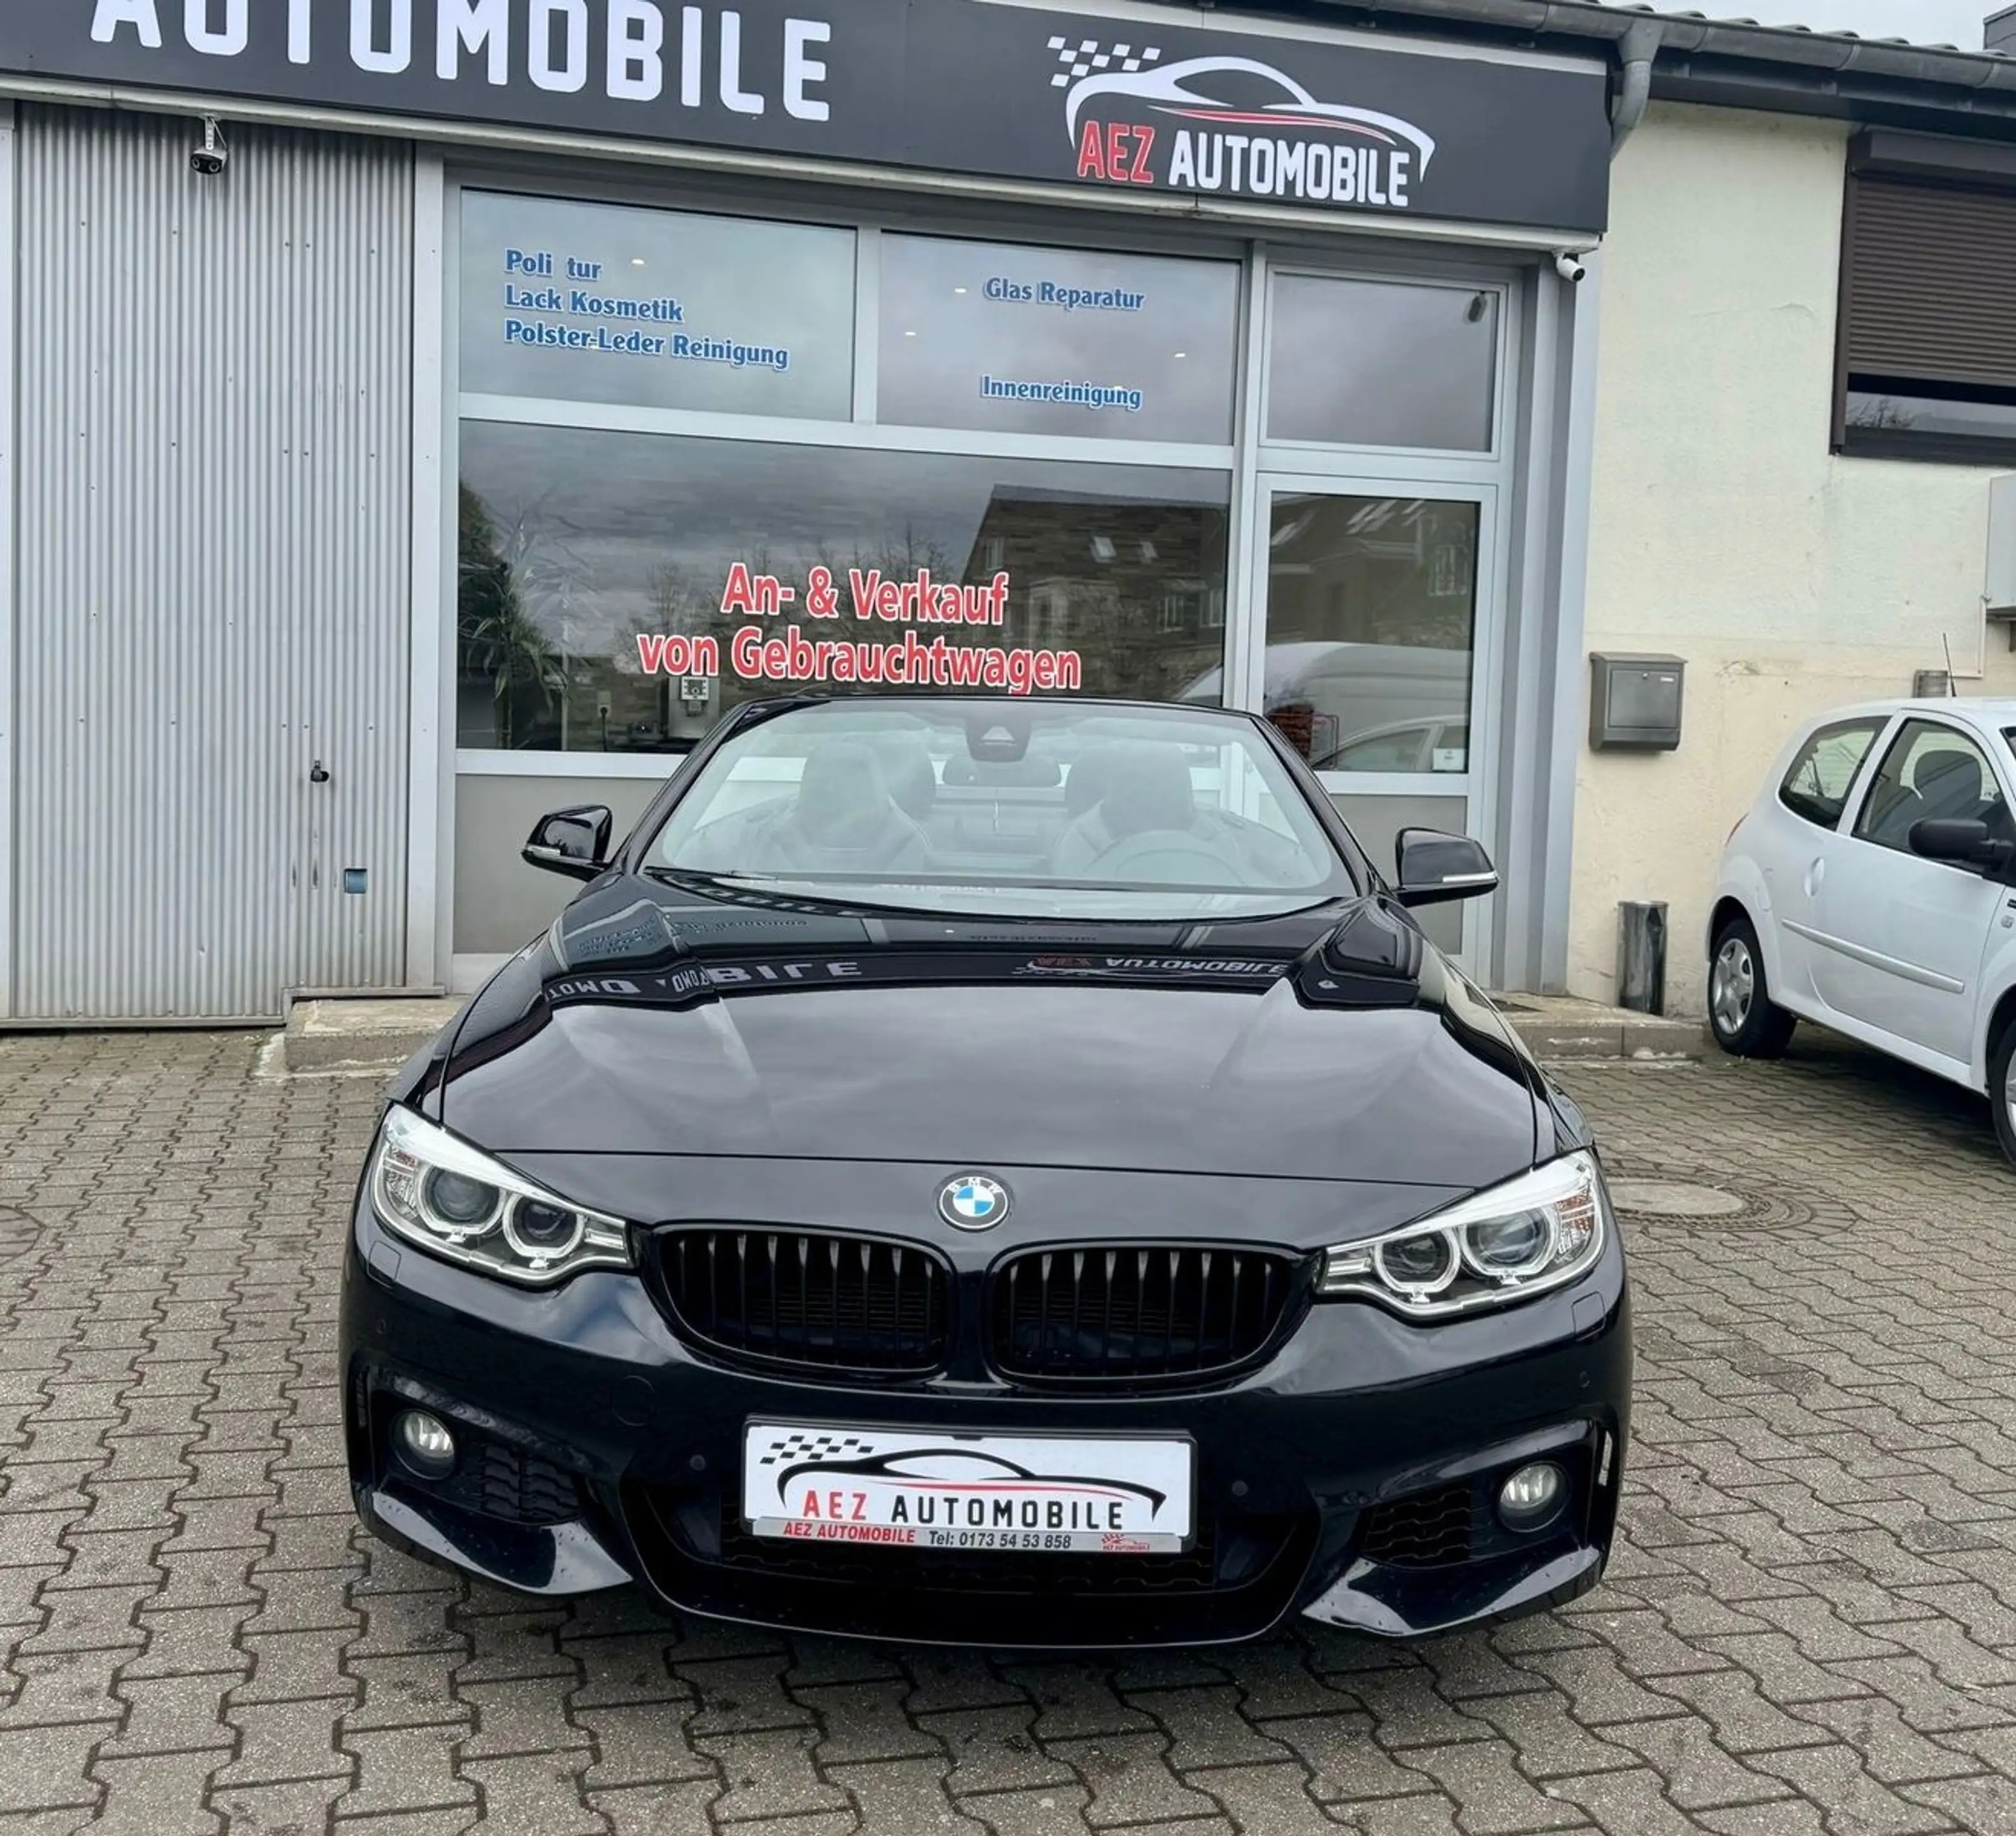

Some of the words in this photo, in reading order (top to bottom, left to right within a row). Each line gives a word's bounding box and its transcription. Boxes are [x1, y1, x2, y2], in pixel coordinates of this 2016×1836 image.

[1077, 120, 1155, 185] AEZ
[1168, 129, 1409, 208] AUTOMOBILE
[504, 284, 562, 311] Lack
[569, 289, 684, 322] Kosmetik
[983, 277, 1033, 301] Glas
[1037, 280, 1145, 310] Reparatur
[504, 318, 664, 355] Polster-Leder
[671, 333, 788, 371] Reinigung
[982, 375, 1142, 411] Innenreinigung
[720, 562, 795, 615] An-
[806, 565, 839, 619] &
[849, 569, 1009, 625] Verkauf
[637, 634, 719, 676] von
[731, 625, 1082, 696] Gebrauchtwagen
[803, 1490, 867, 1520] AEZ
[892, 1495, 1124, 1530] AUTOMOBILE
[783, 1522, 812, 1537] AEZ
[816, 1525, 916, 1543] AUTOMOBILE
[929, 1530, 955, 1545] Tel:
[959, 1532, 996, 1547] 0173
[999, 1533, 1018, 1548] 54
[1022, 1534, 1041, 1548] 53
[1044, 1534, 1072, 1549] 858
